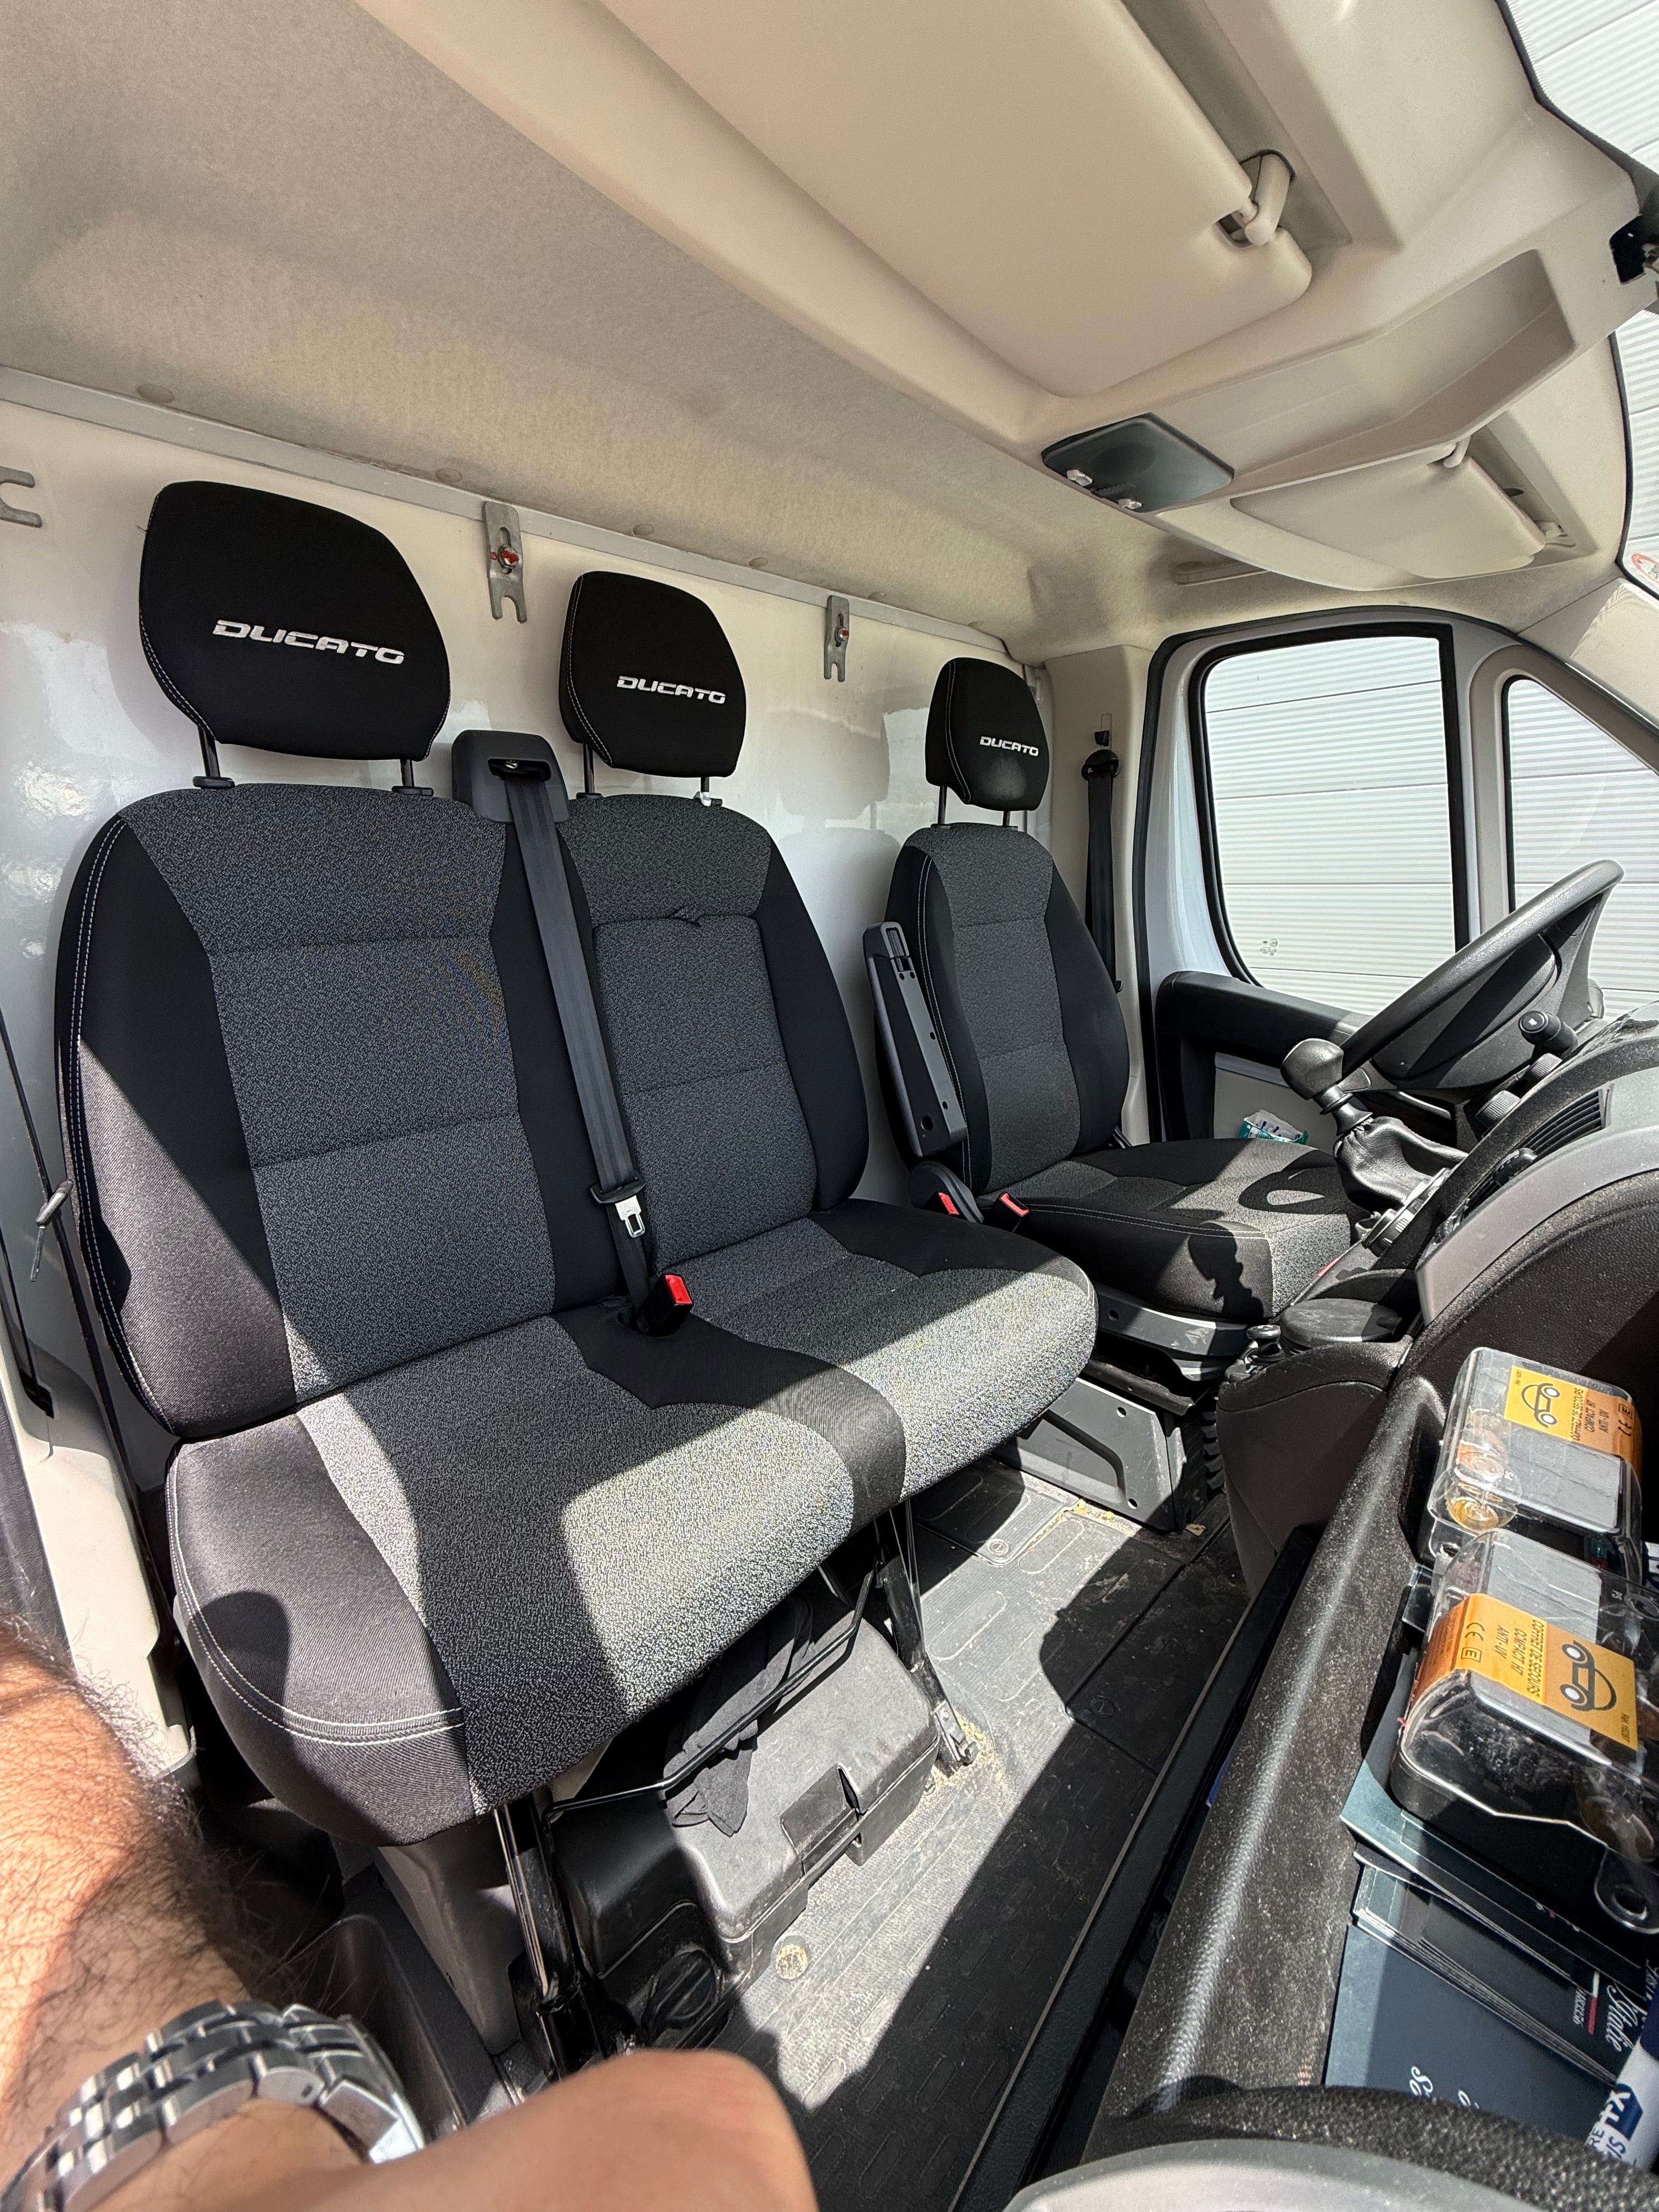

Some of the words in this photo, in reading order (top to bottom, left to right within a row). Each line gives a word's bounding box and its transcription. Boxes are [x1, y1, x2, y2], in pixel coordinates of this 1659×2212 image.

[212, 619, 405, 664] DUCATO
[617, 675, 726, 704] DUCATO
[979, 736, 1039, 757] DUCATO
[1573, 1387, 1584, 1411] SECOURS
[1584, 1407, 1595, 1432] COMPACT
[1511, 1628, 1527, 1664] COMPACT
[1530, 1619, 1545, 1652] COFFRET
[1510, 1661, 1525, 1677] H7
[1529, 1648, 1543, 1663] DE
[1526, 1659, 1543, 1697] SECOURS
